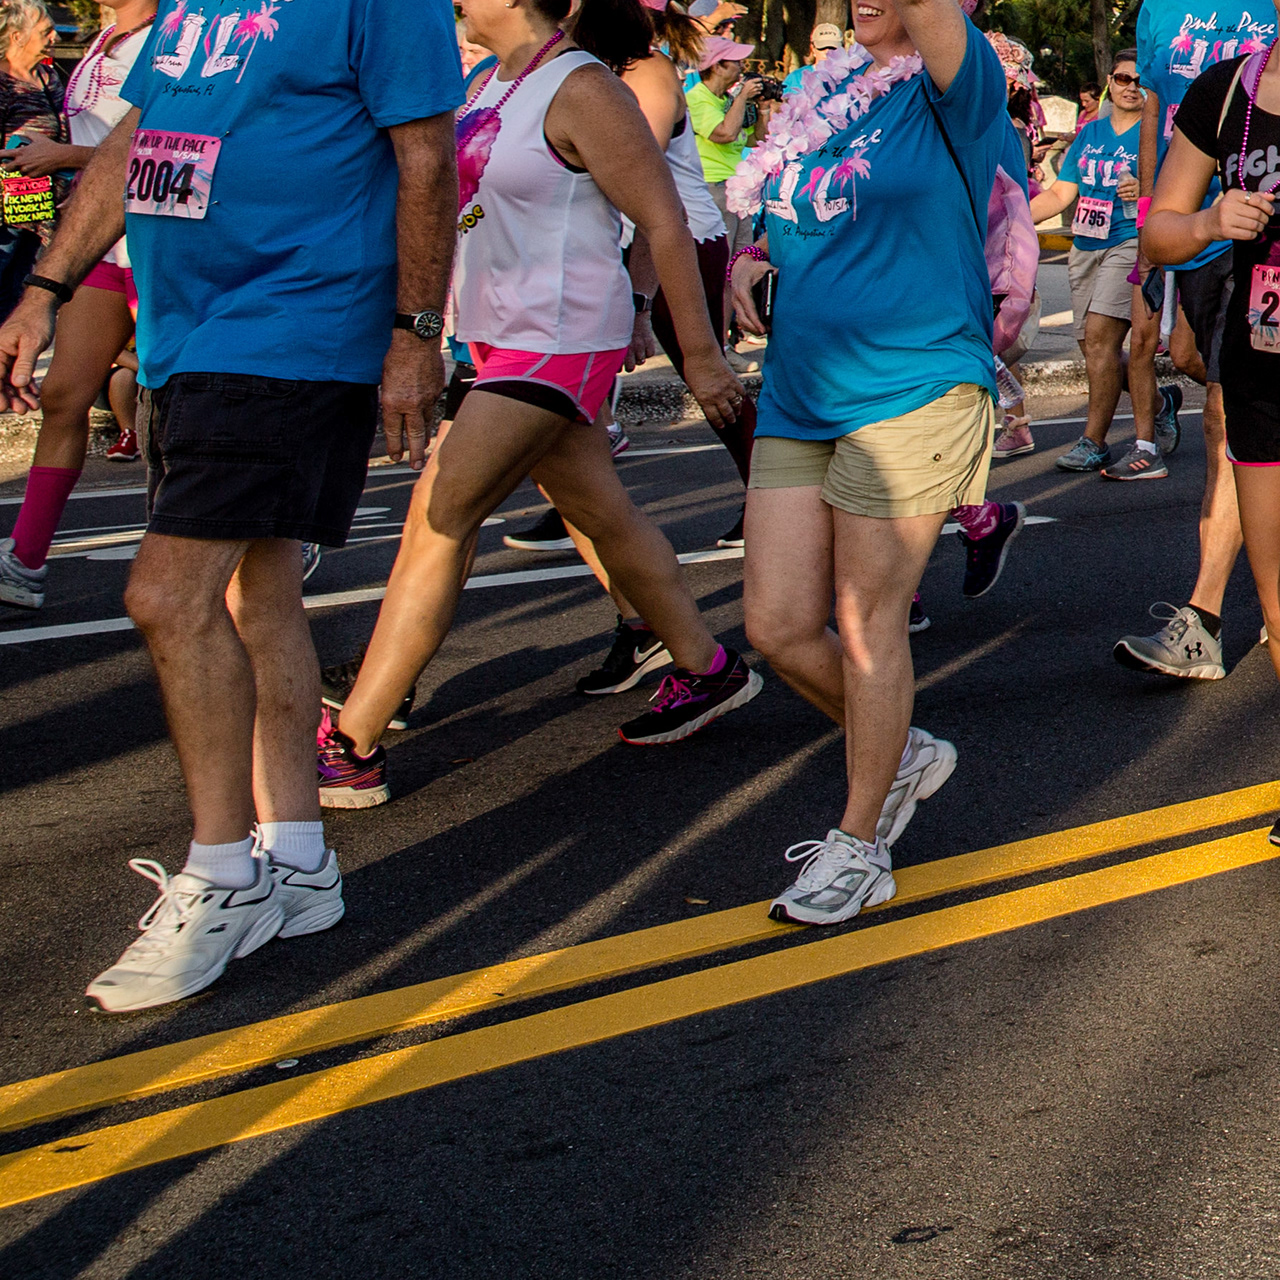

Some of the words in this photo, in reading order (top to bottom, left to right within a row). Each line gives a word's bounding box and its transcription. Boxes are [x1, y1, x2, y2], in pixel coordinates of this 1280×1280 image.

[1179, 11, 1218, 33] Pink
[1237, 10, 1276, 34] Pace
[151, 136, 163, 149] UP
[164, 135, 181, 151] THE
[182, 138, 208, 153] PACE
[1114, 145, 1138, 161] Pace
[126, 157, 196, 205] 2004
[13, 203, 40, 214] YORK
[1076, 207, 1106, 228] 1795
[4, 213, 32, 224] YORK
